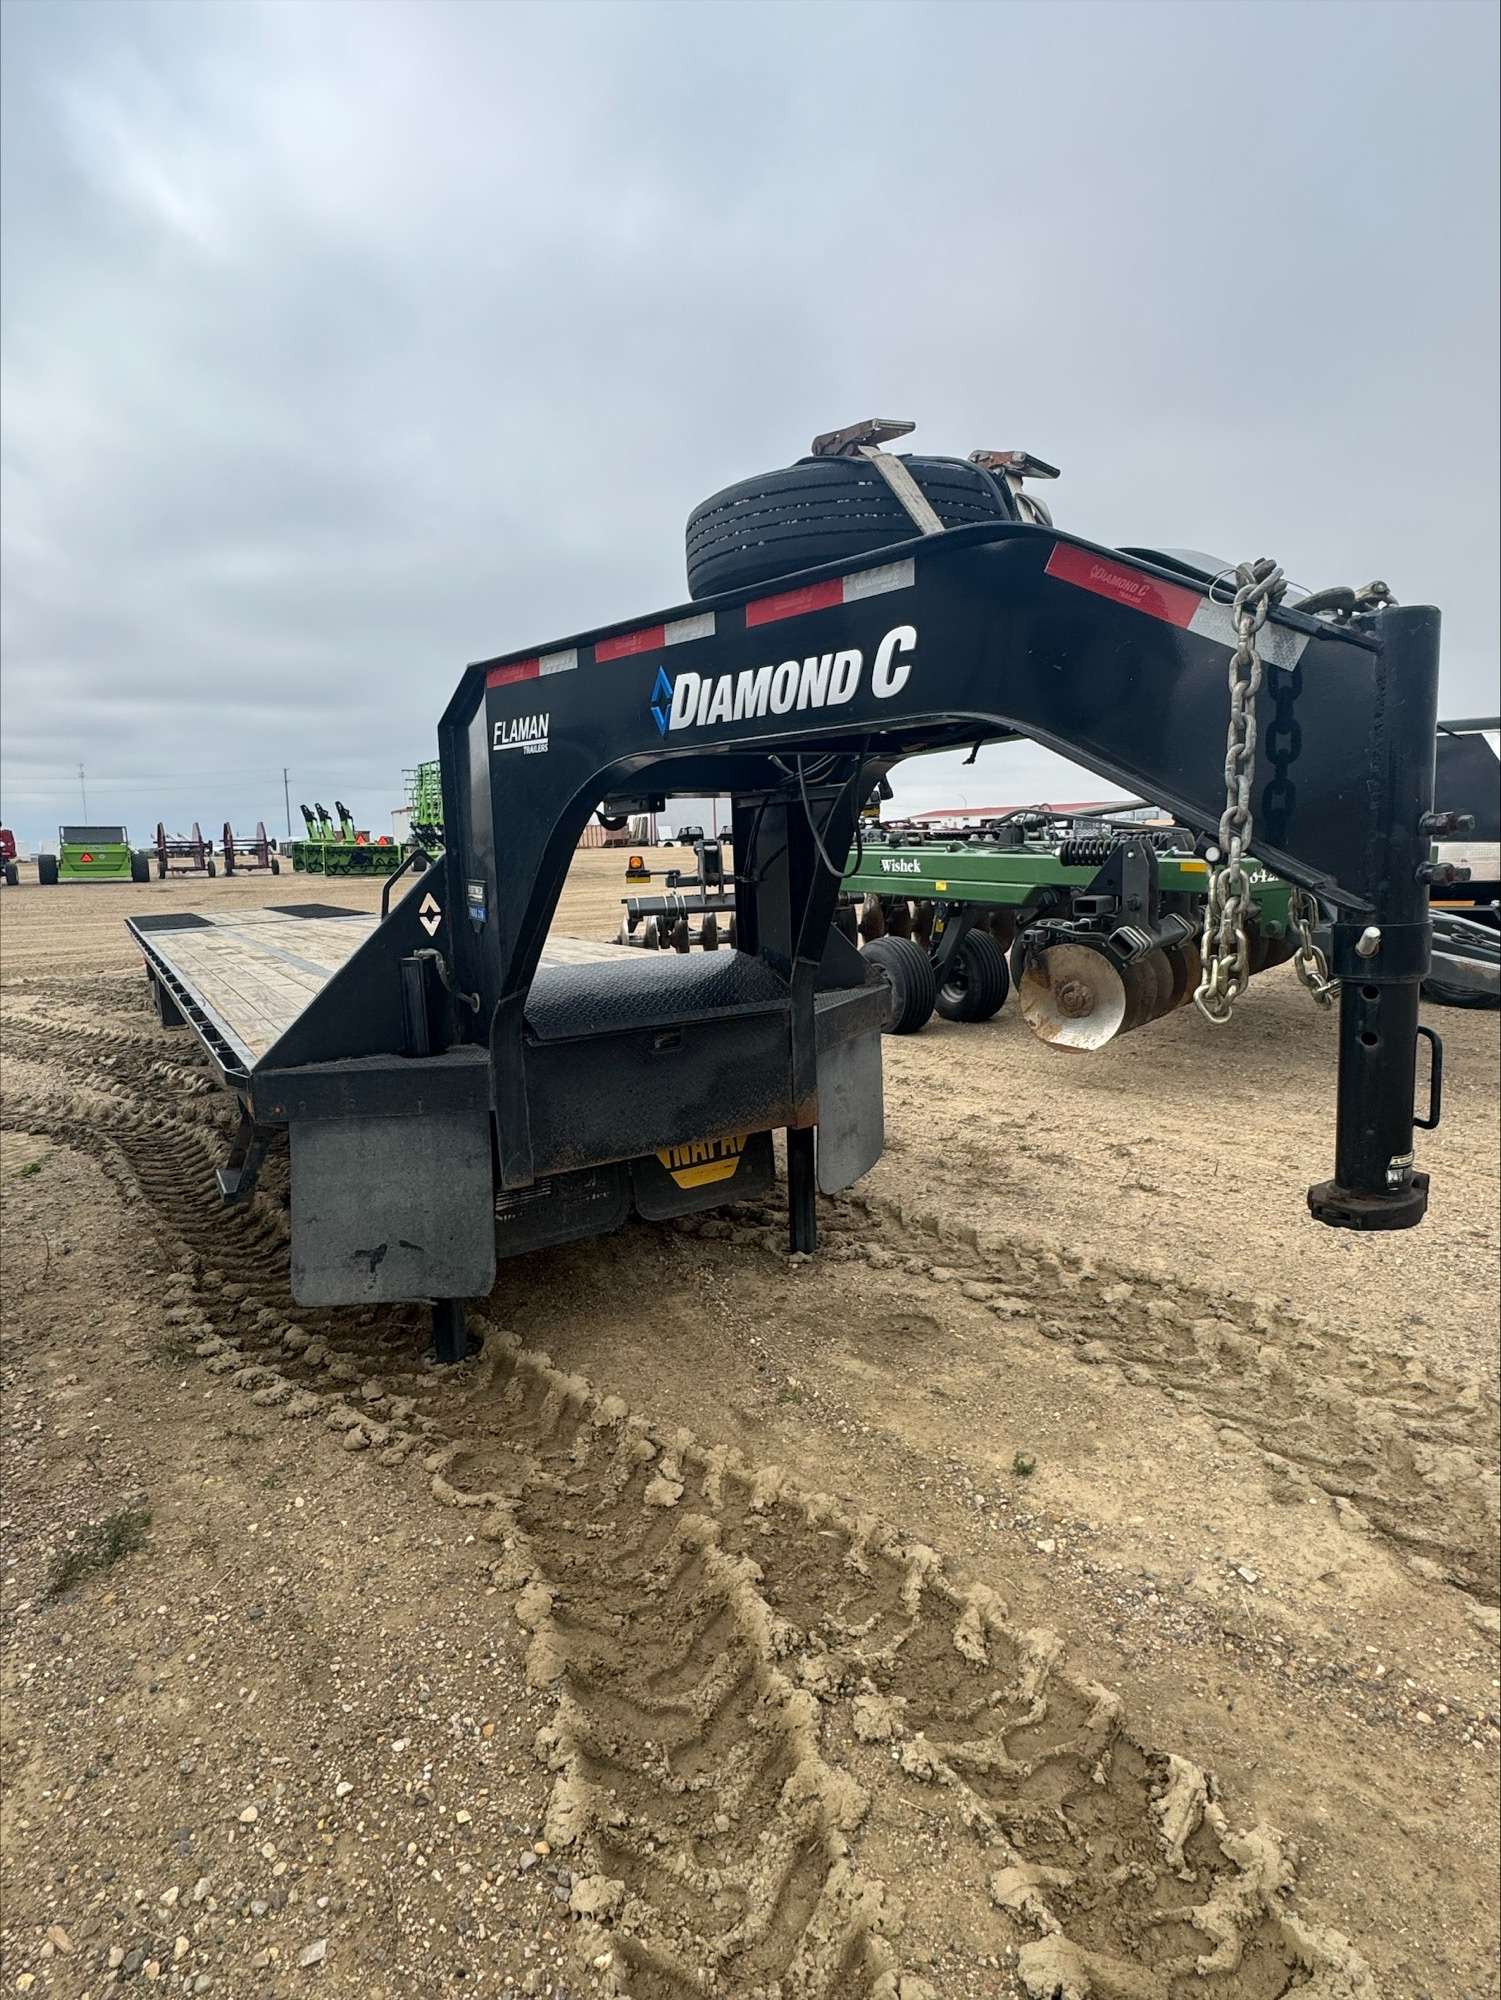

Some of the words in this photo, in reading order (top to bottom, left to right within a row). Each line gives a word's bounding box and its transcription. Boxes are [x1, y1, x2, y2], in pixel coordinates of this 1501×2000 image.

[872, 625, 917, 699] C
[493, 712, 550, 745] FLAMAN
[523, 744, 549, 756] TRAILERS
[881, 857, 922, 873] Wishek
